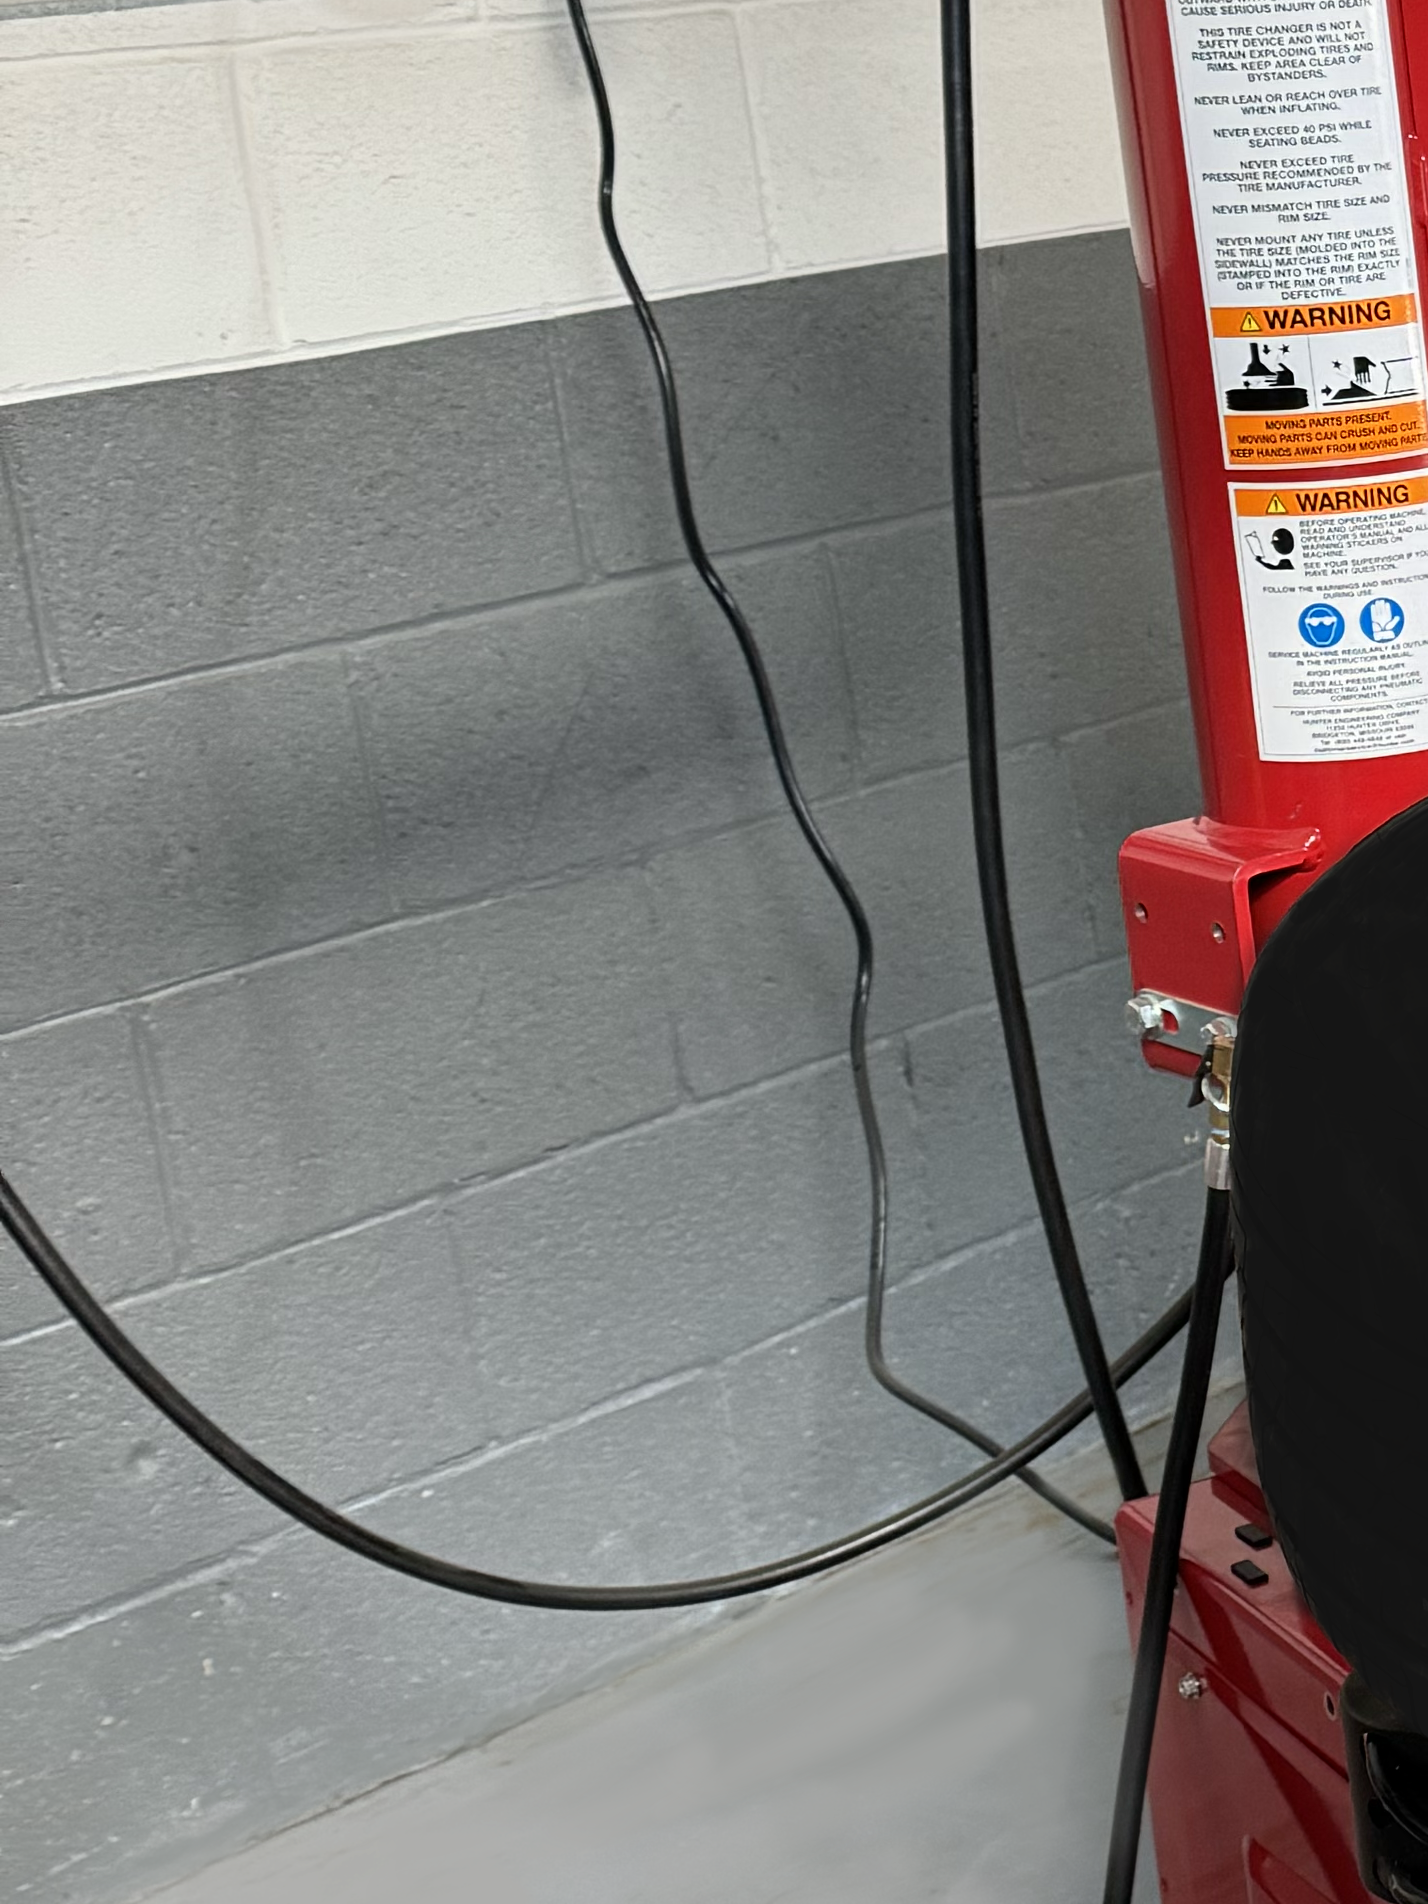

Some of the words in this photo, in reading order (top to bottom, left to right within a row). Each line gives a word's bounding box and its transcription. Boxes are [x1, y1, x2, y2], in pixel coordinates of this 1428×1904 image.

[1180, 6, 1217, 17] CAUSE
[1220, 4, 1271, 15] SERIOUS
[1274, 2, 1316, 12] INJURY
[1319, 0, 1335, 10] OR
[1200, 28, 1224, 38] THIS
[1227, 26, 1253, 36] TIRE
[1255, 24, 1313, 35] CHANGER
[1316, 22, 1327, 32] IS
[1329, 21, 1351, 31] NOT
[1355, 20, 1362, 29] A
[1197, 38, 1239, 49] SAFETY
[1242, 36, 1284, 47] DEVICE
[1288, 35, 1313, 45] AND
[1315, 33, 1341, 44] WILL
[1344, 31, 1365, 41] NOT
[1190, 50, 1246, 62] RESTRAIN
[1249, 47, 1316, 59] EXPLODING
[1320, 44, 1351, 55] TIRES
[1353, 42, 1374, 52] AND
[1240, 60, 1272, 71] KEEP
[1275, 59, 1306, 69] AREA
[1309, 56, 1346, 67] CLEAR
[1347, 55, 1364, 65] OF
[1194, 95, 1229, 106] NEVER
[1232, 94, 1262, 104] LEAN
[1265, 93, 1283, 103] OR
[1285, 91, 1325, 101] REACH
[1328, 88, 1358, 99] OVER
[1361, 86, 1381, 96] TIRE
[1241, 106, 1276, 115] WHEN
[1213, 127, 1250, 138] NEVER
[1253, 125, 1300, 136] EXCEED
[1303, 125, 1316, 134] 40
[1318, 123, 1336, 132] PSI
[1339, 120, 1372, 131] WHILE
[1248, 137, 1297, 149] SEATING
[1240, 159, 1278, 170] NEVER
[1281, 156, 1327, 168] EXCEED
[1331, 154, 1354, 164] TIRE
[1202, 171, 1260, 183] PRESSURE
[1262, 166, 1354, 179] RECOMMENDED
[1357, 164, 1371, 173] BY
[1374, 162, 1392, 171] THE
[1238, 183, 1263, 193] TIRE
[1212, 204, 1248, 215] NEVER
[1251, 201, 1313, 213] MISMATCH
[1315, 199, 1341, 209] TIRE
[1343, 197, 1366, 207] SIZE
[1369, 195, 1391, 204] AND
[1276, 214, 1300, 223] RIM
[1216, 236, 1252, 247] NEVER
[1254, 234, 1297, 245] MOUNT
[1301, 232, 1324, 242] ANY
[1327, 230, 1351, 240] TIRE
[1354, 226, 1394, 238] UNLESS
[1215, 248, 1237, 258] THE
[1239, 247, 1264, 257] TIRE
[1267, 245, 1292, 255] SIZE
[1350, 240, 1376, 250] INTO
[1379, 237, 1398, 247] THE
[1275, 254, 1330, 266] MATCHES
[1334, 253, 1354, 262] THE
[1358, 251, 1377, 260] RIM
[1379, 248, 1401, 258] SIZE
[1274, 267, 1302, 277] INTO
[1305, 266, 1327, 275] THE
[1357, 260, 1400, 272] EXACTLY
[1236, 281, 1253, 291] OR
[1255, 281, 1266, 290] IF
[1268, 279, 1290, 289] THE
[1293, 278, 1315, 288] RIM
[1318, 276, 1335, 286] OR
[1339, 275, 1362, 285] TIRE
[1365, 272, 1387, 282] ARE
[1263, 301, 1391, 329] WARNING
[1265, 418, 1307, 429] MOVING
[1308, 415, 1344, 426] PARTS
[1236, 433, 1278, 444] MOVING
[1278, 430, 1314, 441] PARTS
[1314, 428, 1339, 438] CAN
[1338, 425, 1377, 436] CRUSH
[1376, 424, 1399, 433] AND
[1228, 448, 1255, 458] KEEP
[1255, 445, 1294, 456] HANDS
[1293, 443, 1325, 453] AWAY
[1325, 440, 1358, 450] FROM
[1358, 437, 1399, 448] MOVING
[1296, 484, 1409, 512] WARNING
